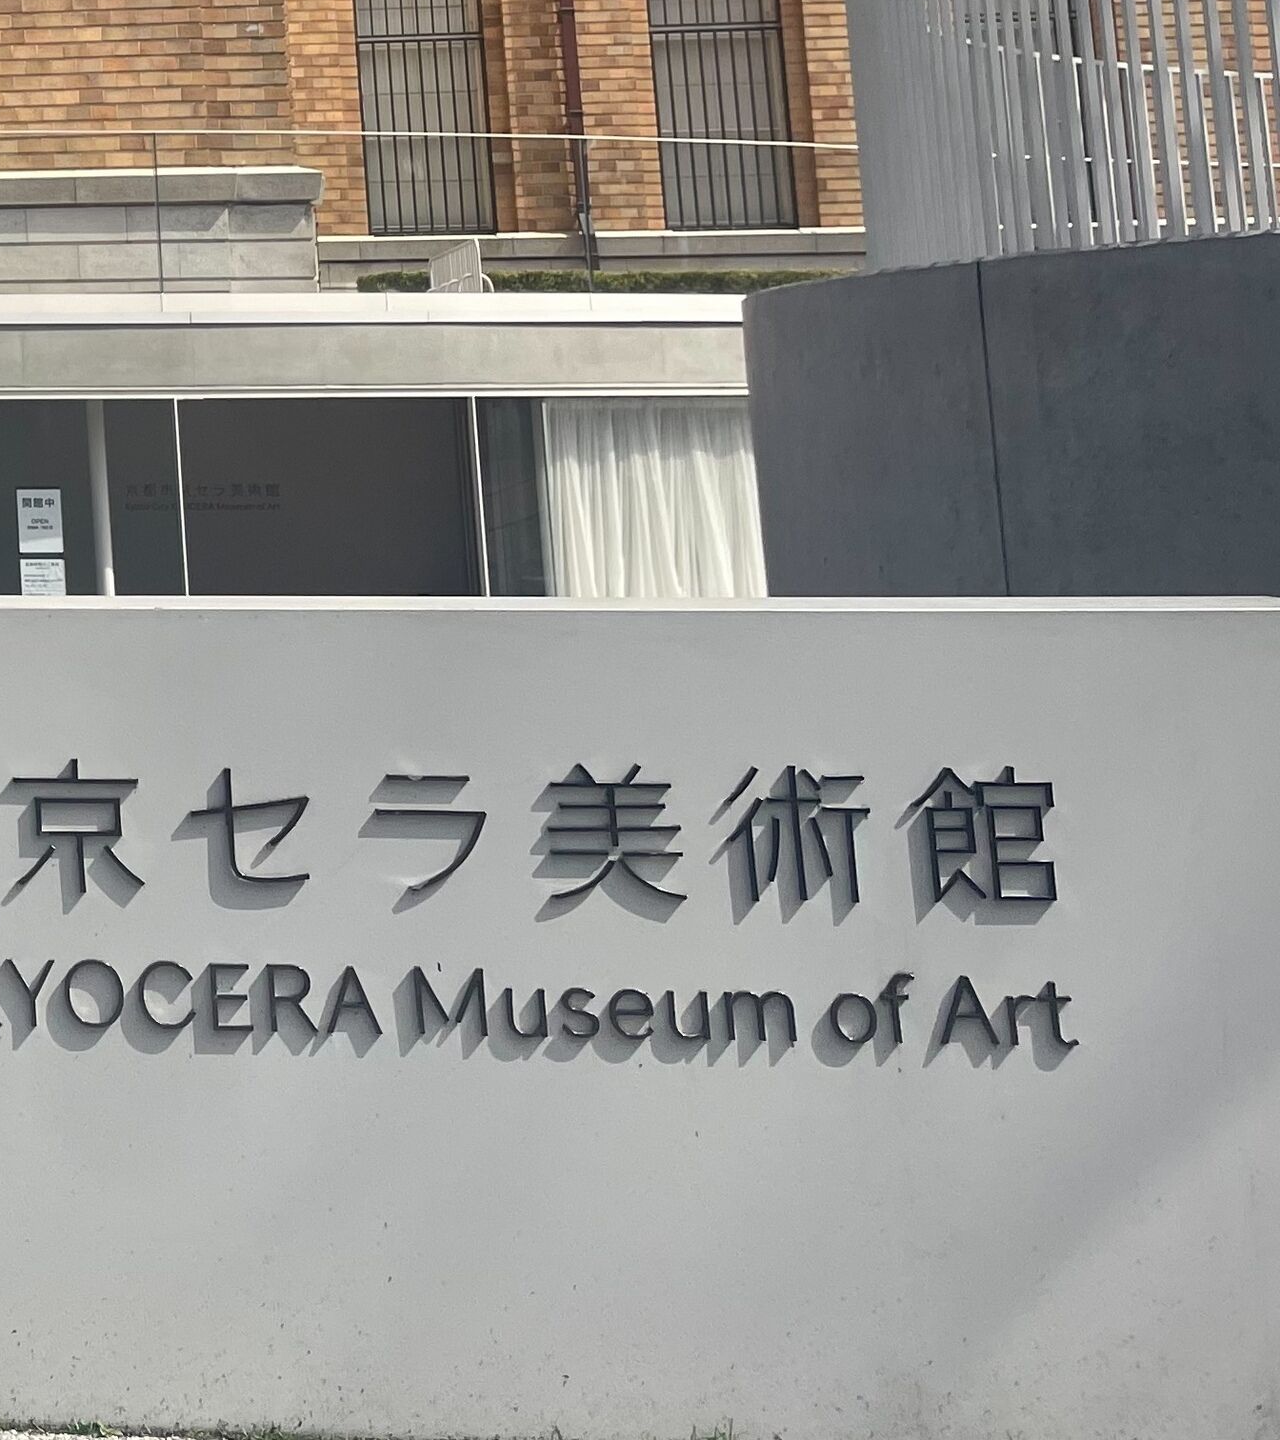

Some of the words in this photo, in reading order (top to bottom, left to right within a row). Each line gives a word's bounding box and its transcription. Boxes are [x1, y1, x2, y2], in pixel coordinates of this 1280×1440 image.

[22, 498, 55, 508] 開館中
[412, 965, 798, 1047] Museum
[831, 972, 915, 1046] of
[940, 975, 1081, 1048] Art
